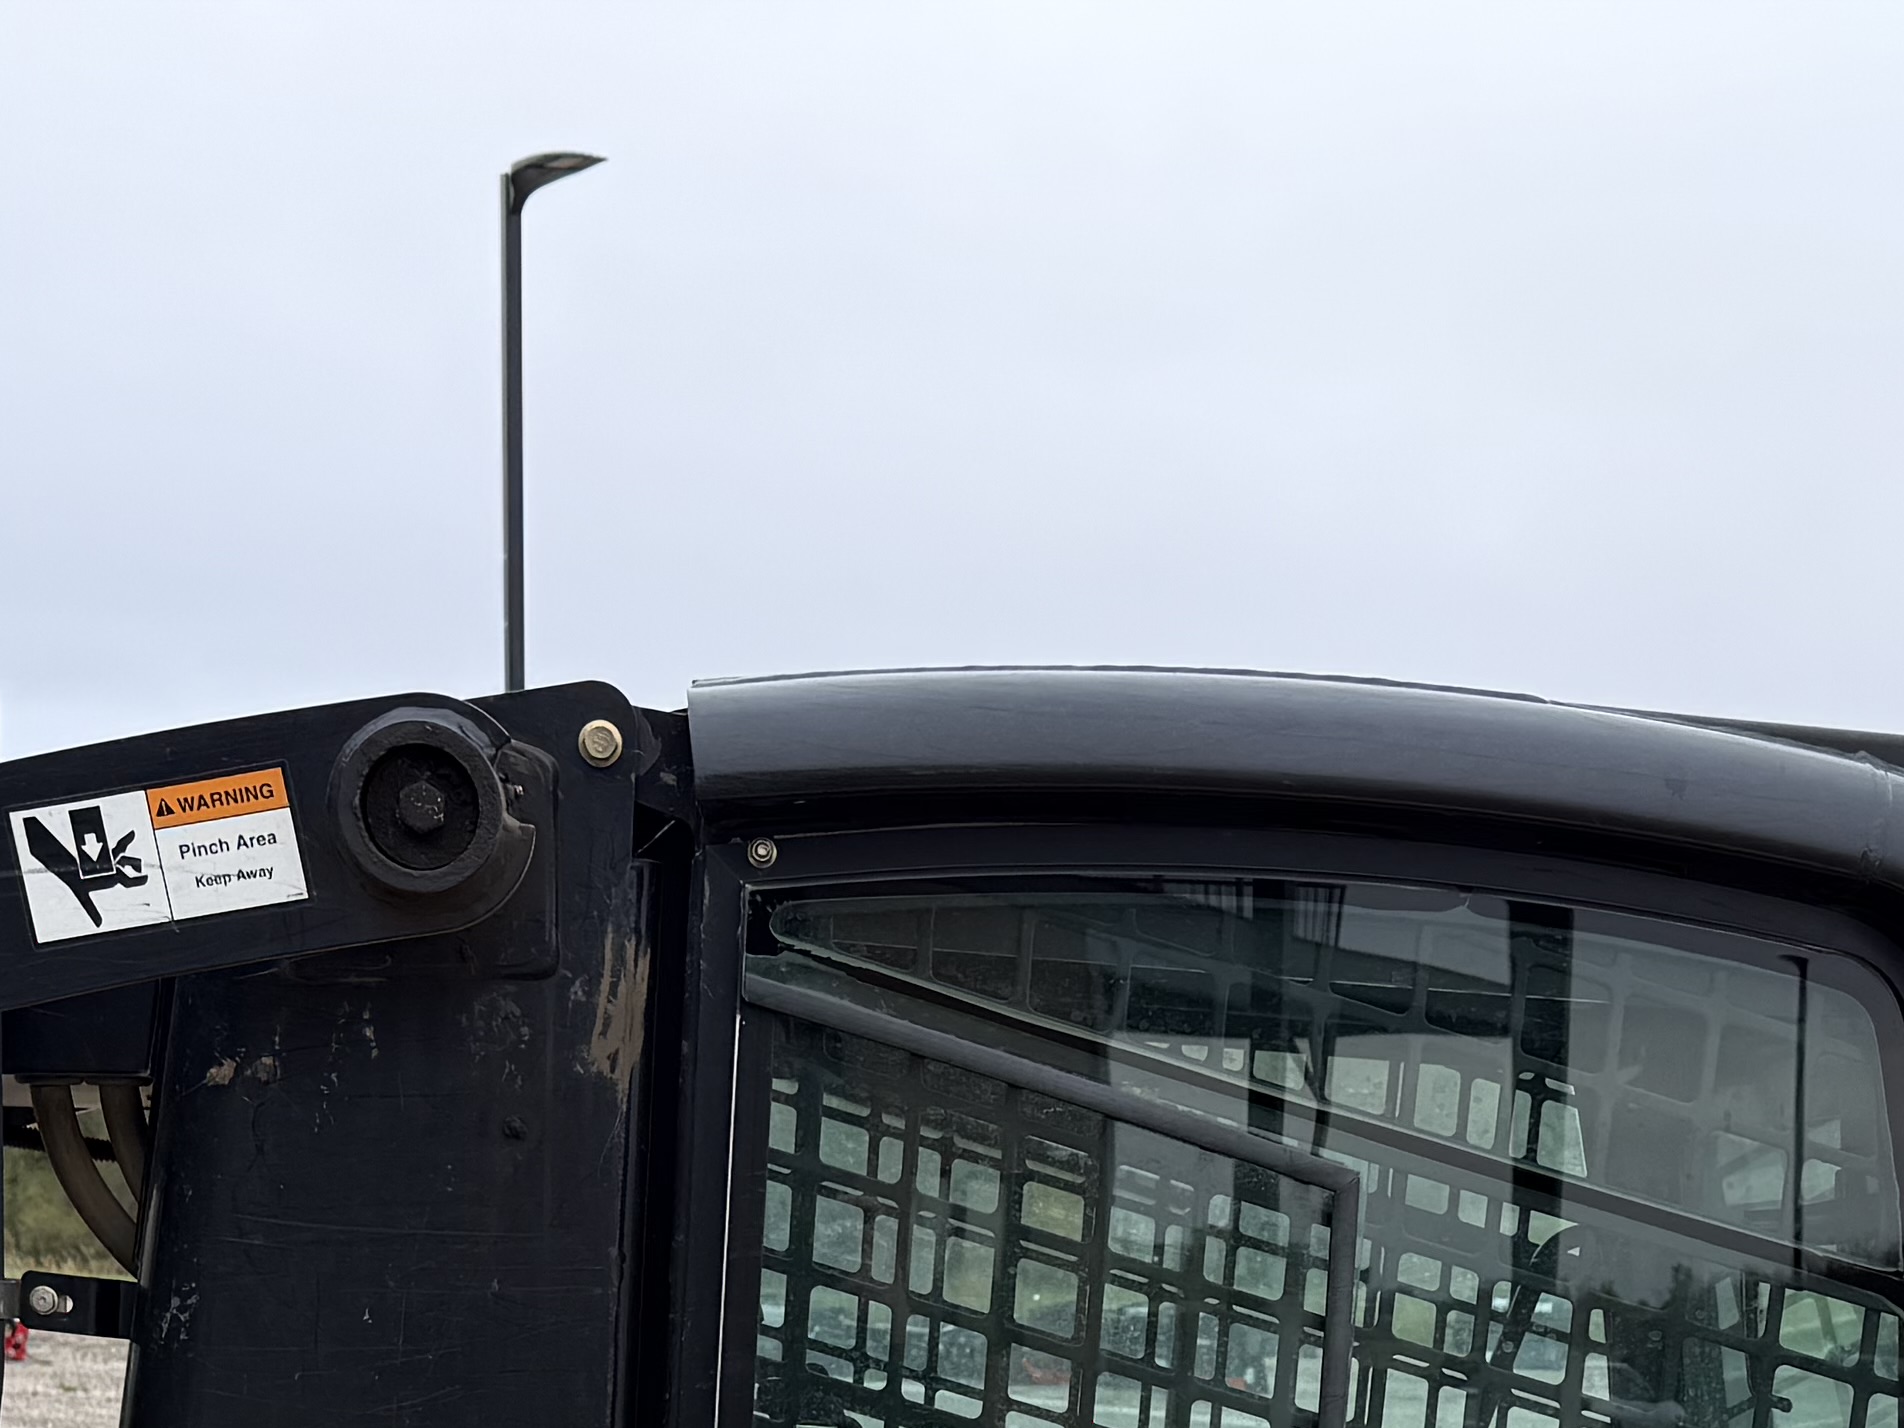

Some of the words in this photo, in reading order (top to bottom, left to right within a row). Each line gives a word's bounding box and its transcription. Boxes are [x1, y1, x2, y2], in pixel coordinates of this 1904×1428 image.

[176, 782, 275, 814] WARNING
[179, 837, 230, 860] Pinch
[237, 831, 277, 851] Area
[195, 872, 232, 889] Keep
[237, 866, 274, 883] Away
